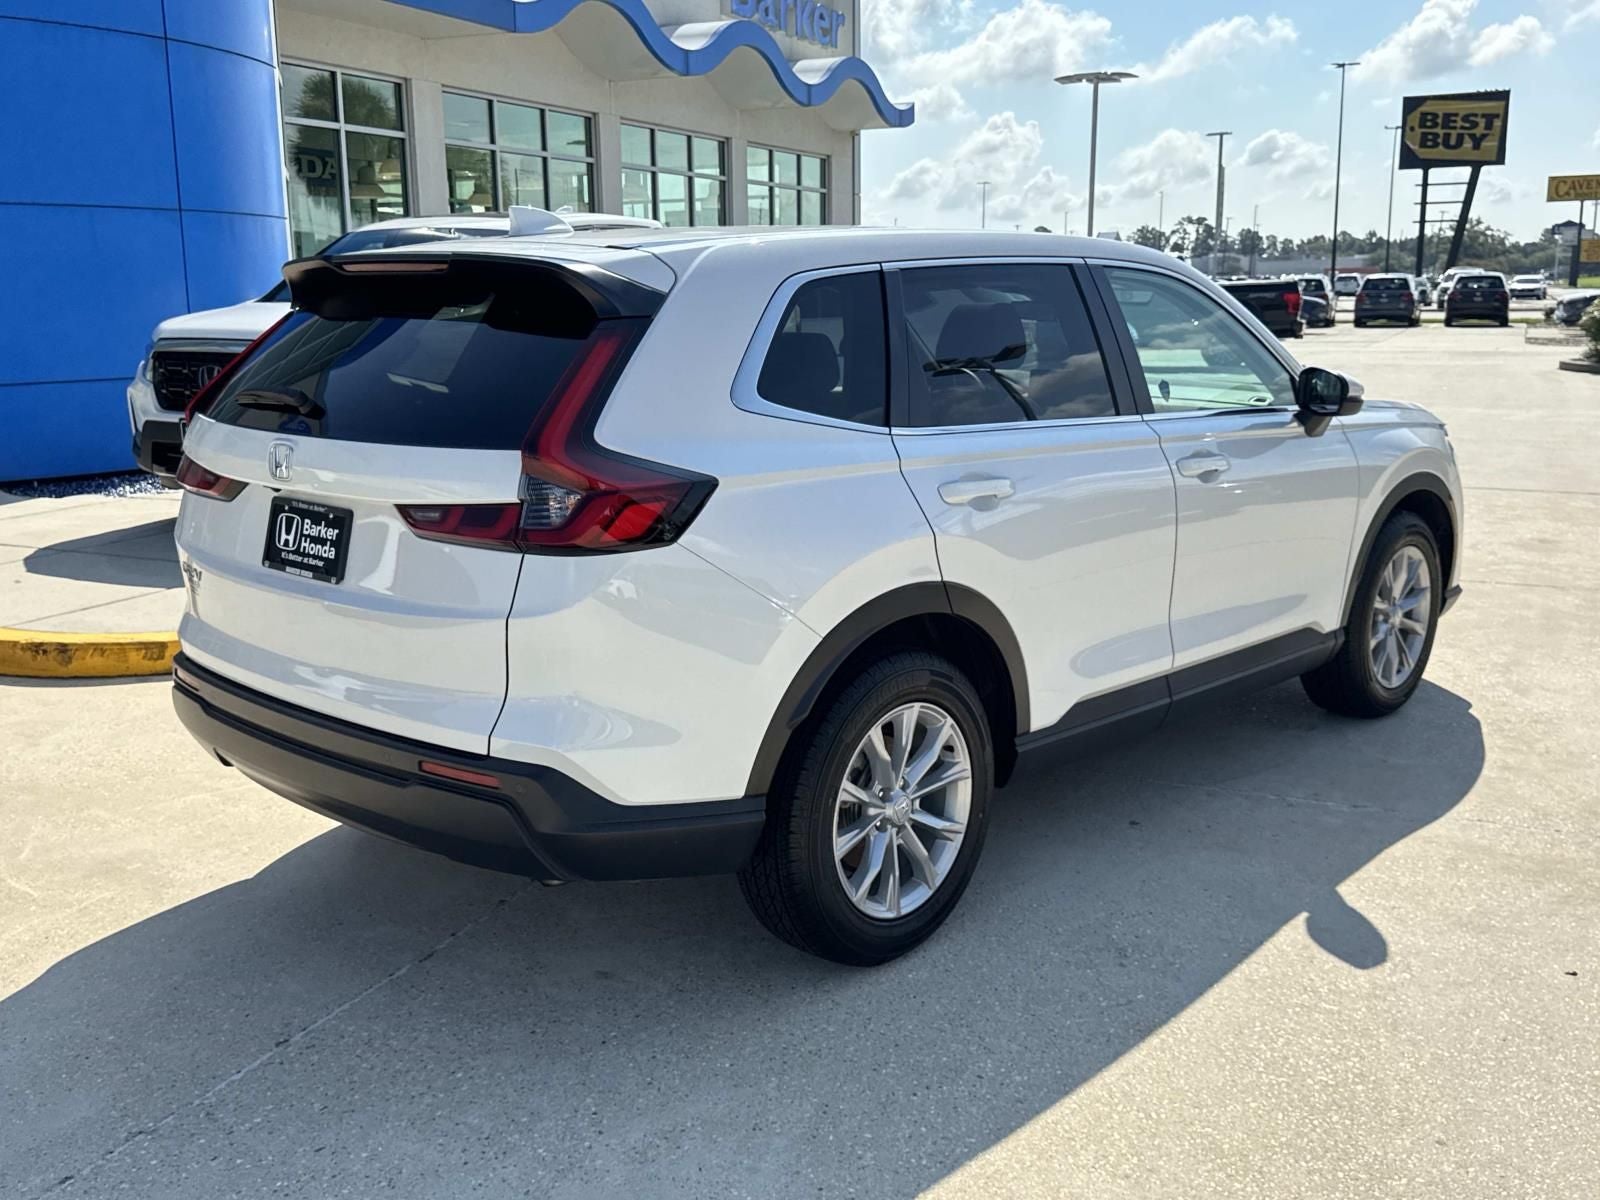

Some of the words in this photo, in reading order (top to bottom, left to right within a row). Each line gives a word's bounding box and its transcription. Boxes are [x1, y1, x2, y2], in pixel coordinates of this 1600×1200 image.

[1418, 112, 1500, 131] BEST
[1418, 131, 1490, 151] BUY
[303, 518, 339, 541] Barker
[300, 537, 336, 559] Honda
